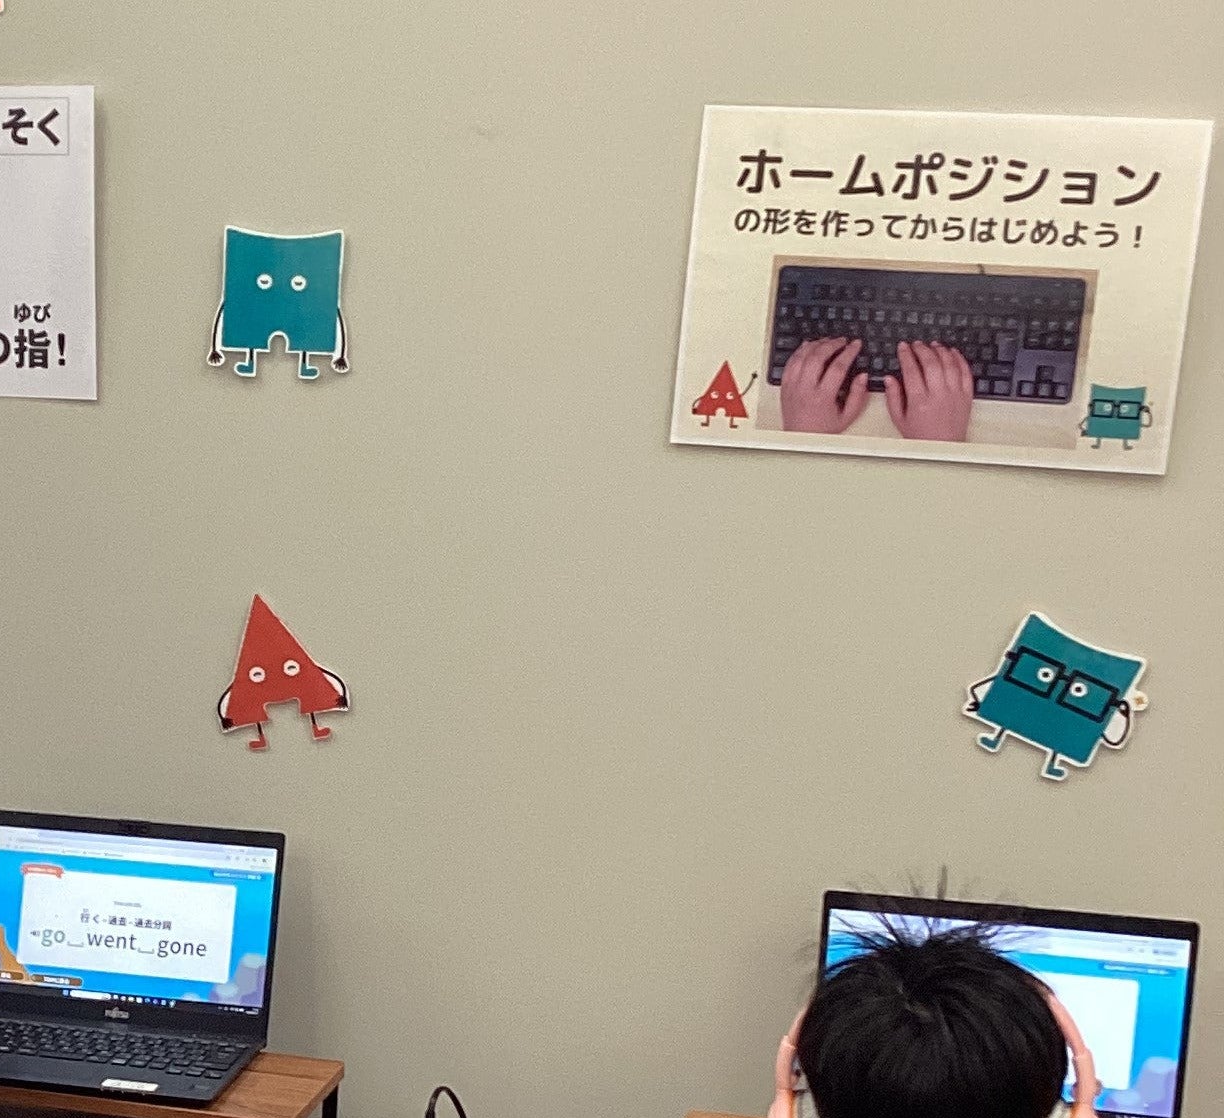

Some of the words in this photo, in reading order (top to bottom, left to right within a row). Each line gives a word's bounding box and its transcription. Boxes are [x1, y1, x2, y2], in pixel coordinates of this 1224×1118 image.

[735, 148, 1162, 207] ホームポジション
[734, 208, 1143, 249] の形を作ってからはじめよう！
[13, 303, 51, 323] ゆび
[87, 933, 137, 951] went
[156, 940, 207, 958] gone
